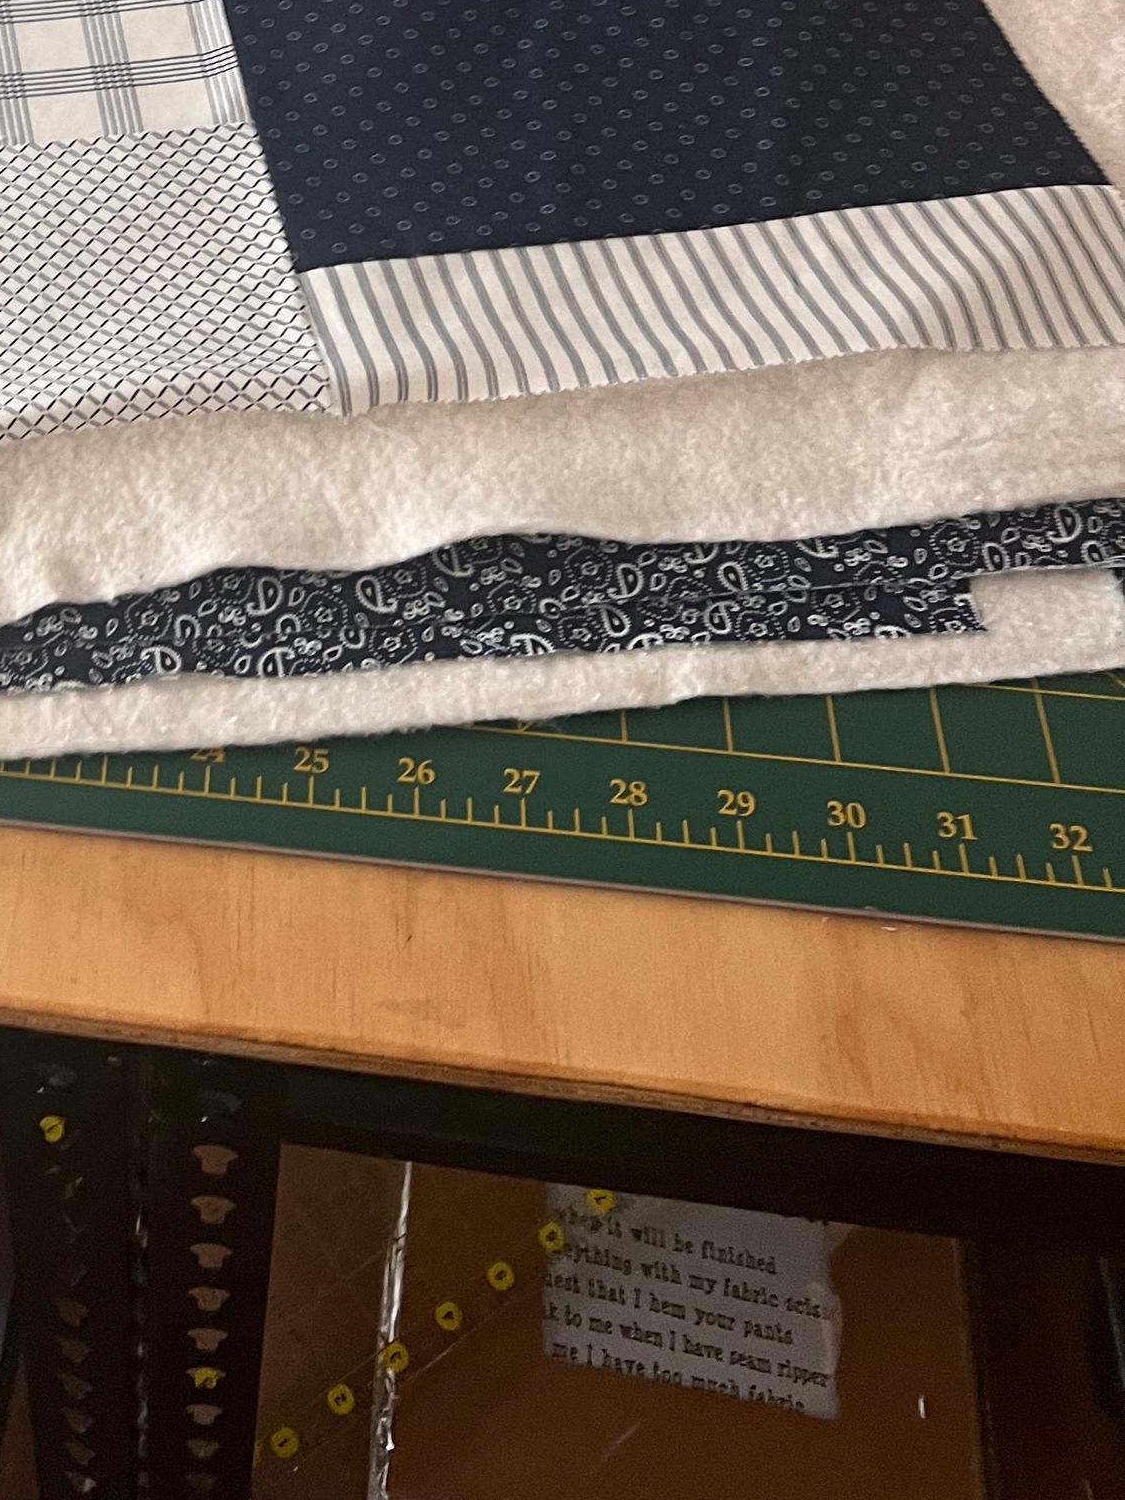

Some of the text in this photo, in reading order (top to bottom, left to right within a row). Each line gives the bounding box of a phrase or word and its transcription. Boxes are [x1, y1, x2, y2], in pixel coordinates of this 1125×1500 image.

[292, 746, 330, 774] 25
[396, 757, 436, 786] 26
[503, 767, 541, 795] 27
[609, 778, 648, 807] 28
[717, 789, 756, 818] 29
[826, 800, 867, 830] 30
[936, 811, 978, 841] 31
[1049, 823, 1093, 853] 32
[630, 1226, 666, 1249] will
[702, 1240, 778, 1276] finished
[588, 1276, 626, 1306] that
[634, 1288, 642, 1308] I
[650, 1292, 686, 1320] hem
[695, 1307, 736, 1331] your
[744, 1319, 794, 1345] pants
[641, 1260, 683, 1285] with
[689, 1275, 717, 1295] my
[723, 1278, 779, 1308] fabric
[552, 1342, 578, 1361] me
[586, 1342, 593, 1366] I
[601, 1348, 645, 1377] have
[653, 1360, 683, 1384] too
[588, 1317, 613, 1335] me
[619, 1321, 663, 1348] when
[669, 1330, 676, 1352] I
[683, 1333, 724, 1362] have
[730, 1350, 772, 1375] seam
